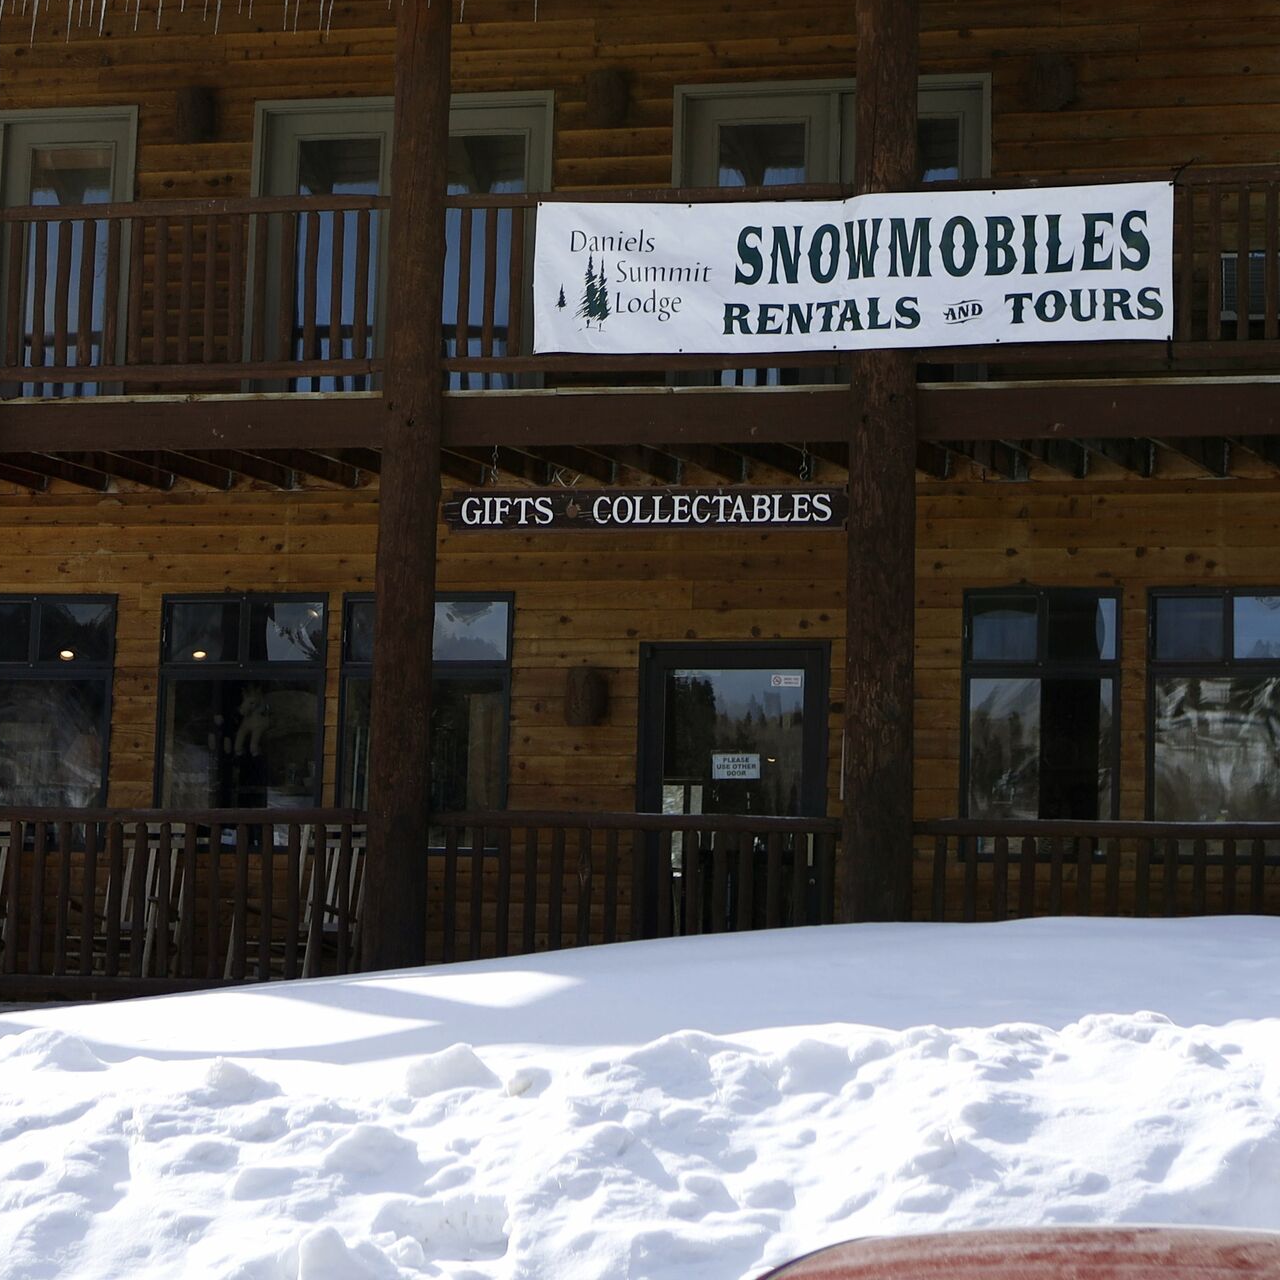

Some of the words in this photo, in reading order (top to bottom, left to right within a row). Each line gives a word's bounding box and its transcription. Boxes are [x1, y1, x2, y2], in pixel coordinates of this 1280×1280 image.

[570, 229, 656, 252] Daniels
[734, 210, 1152, 286] SNOWMOBILES
[615, 260, 713, 283] Summit
[615, 289, 682, 321] Lodge
[722, 296, 921, 336] RENTALS
[943, 302, 984, 321] AND
[1003, 286, 1165, 325] TOURS
[460, 496, 554, 526] GIFTS
[592, 493, 833, 525] COLLECTABLES
